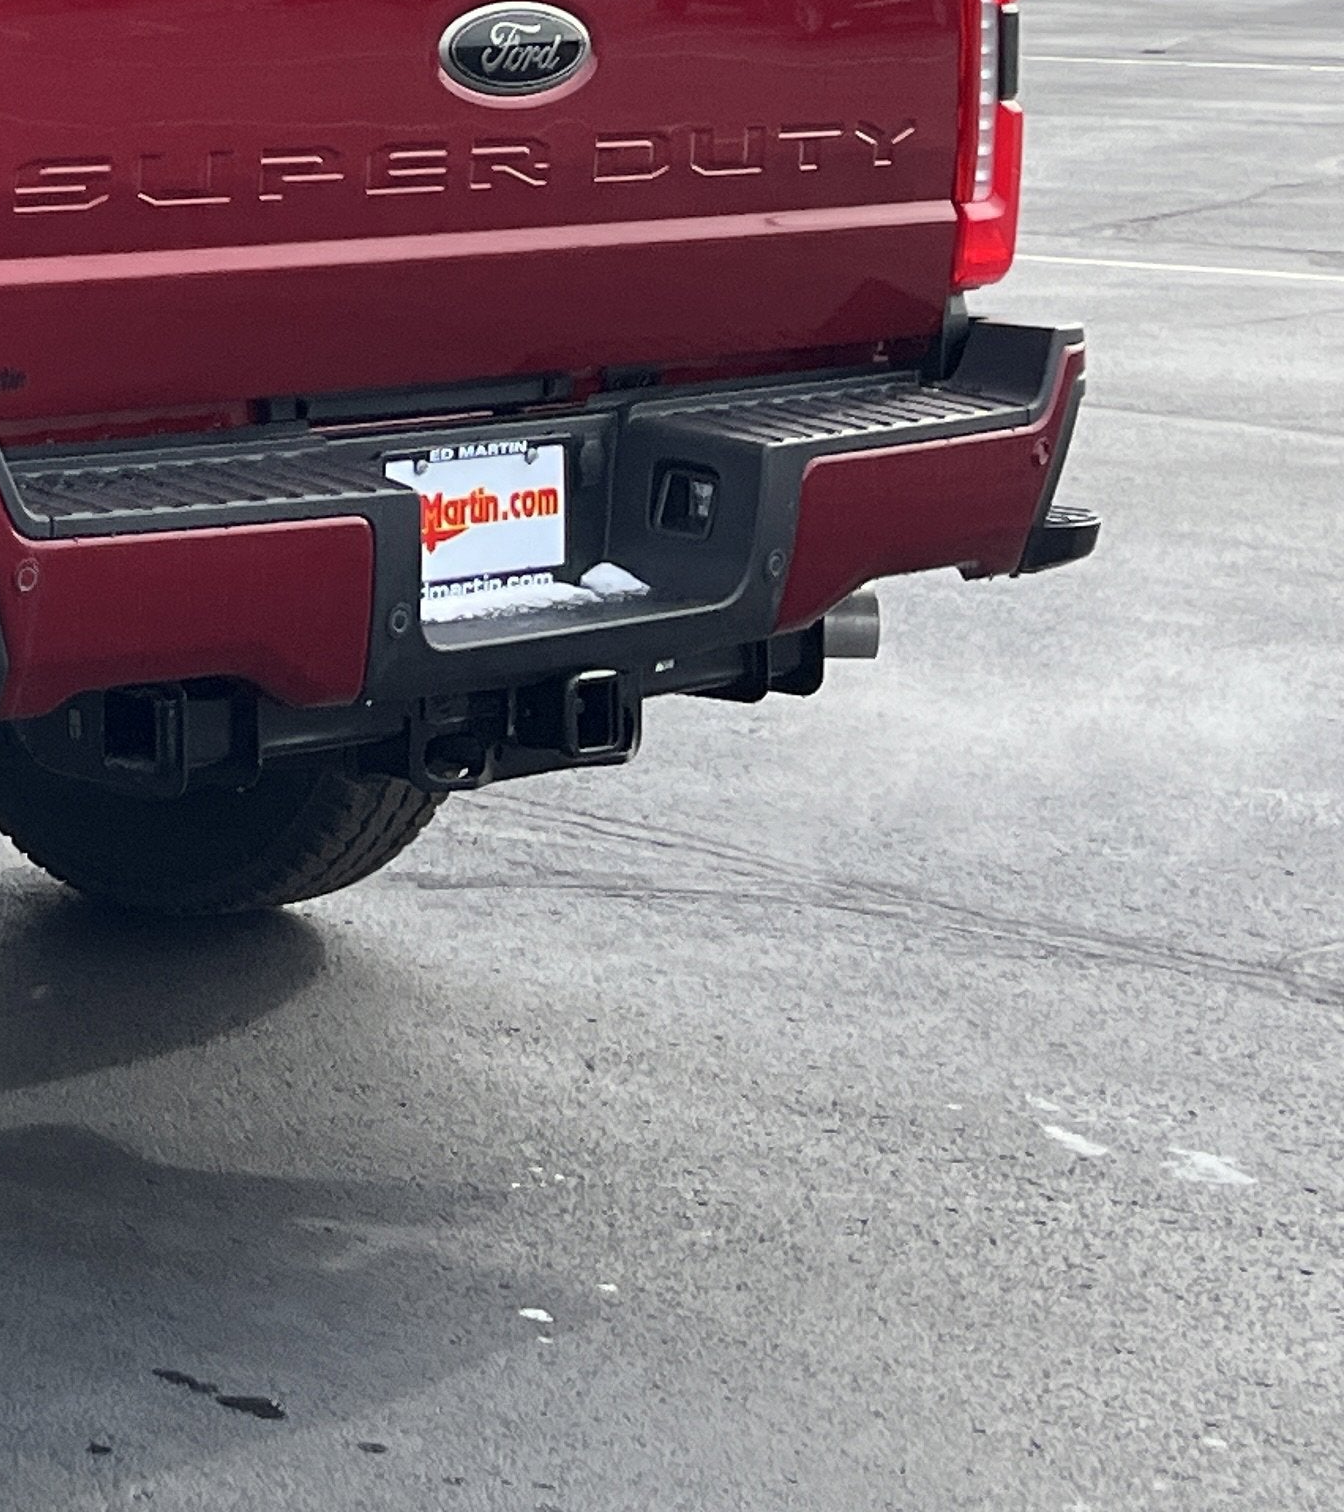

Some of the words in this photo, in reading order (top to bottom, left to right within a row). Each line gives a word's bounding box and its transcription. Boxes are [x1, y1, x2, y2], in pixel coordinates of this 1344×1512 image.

[481, 21, 562, 73] Ford
[13, 138, 550, 214] SUPER
[594, 119, 916, 184] DUTY
[429, 447, 455, 462] ED
[457, 440, 528, 460] MARTIN
[420, 487, 558, 529] Martin.com
[420, 572, 553, 600] dmartin.com
